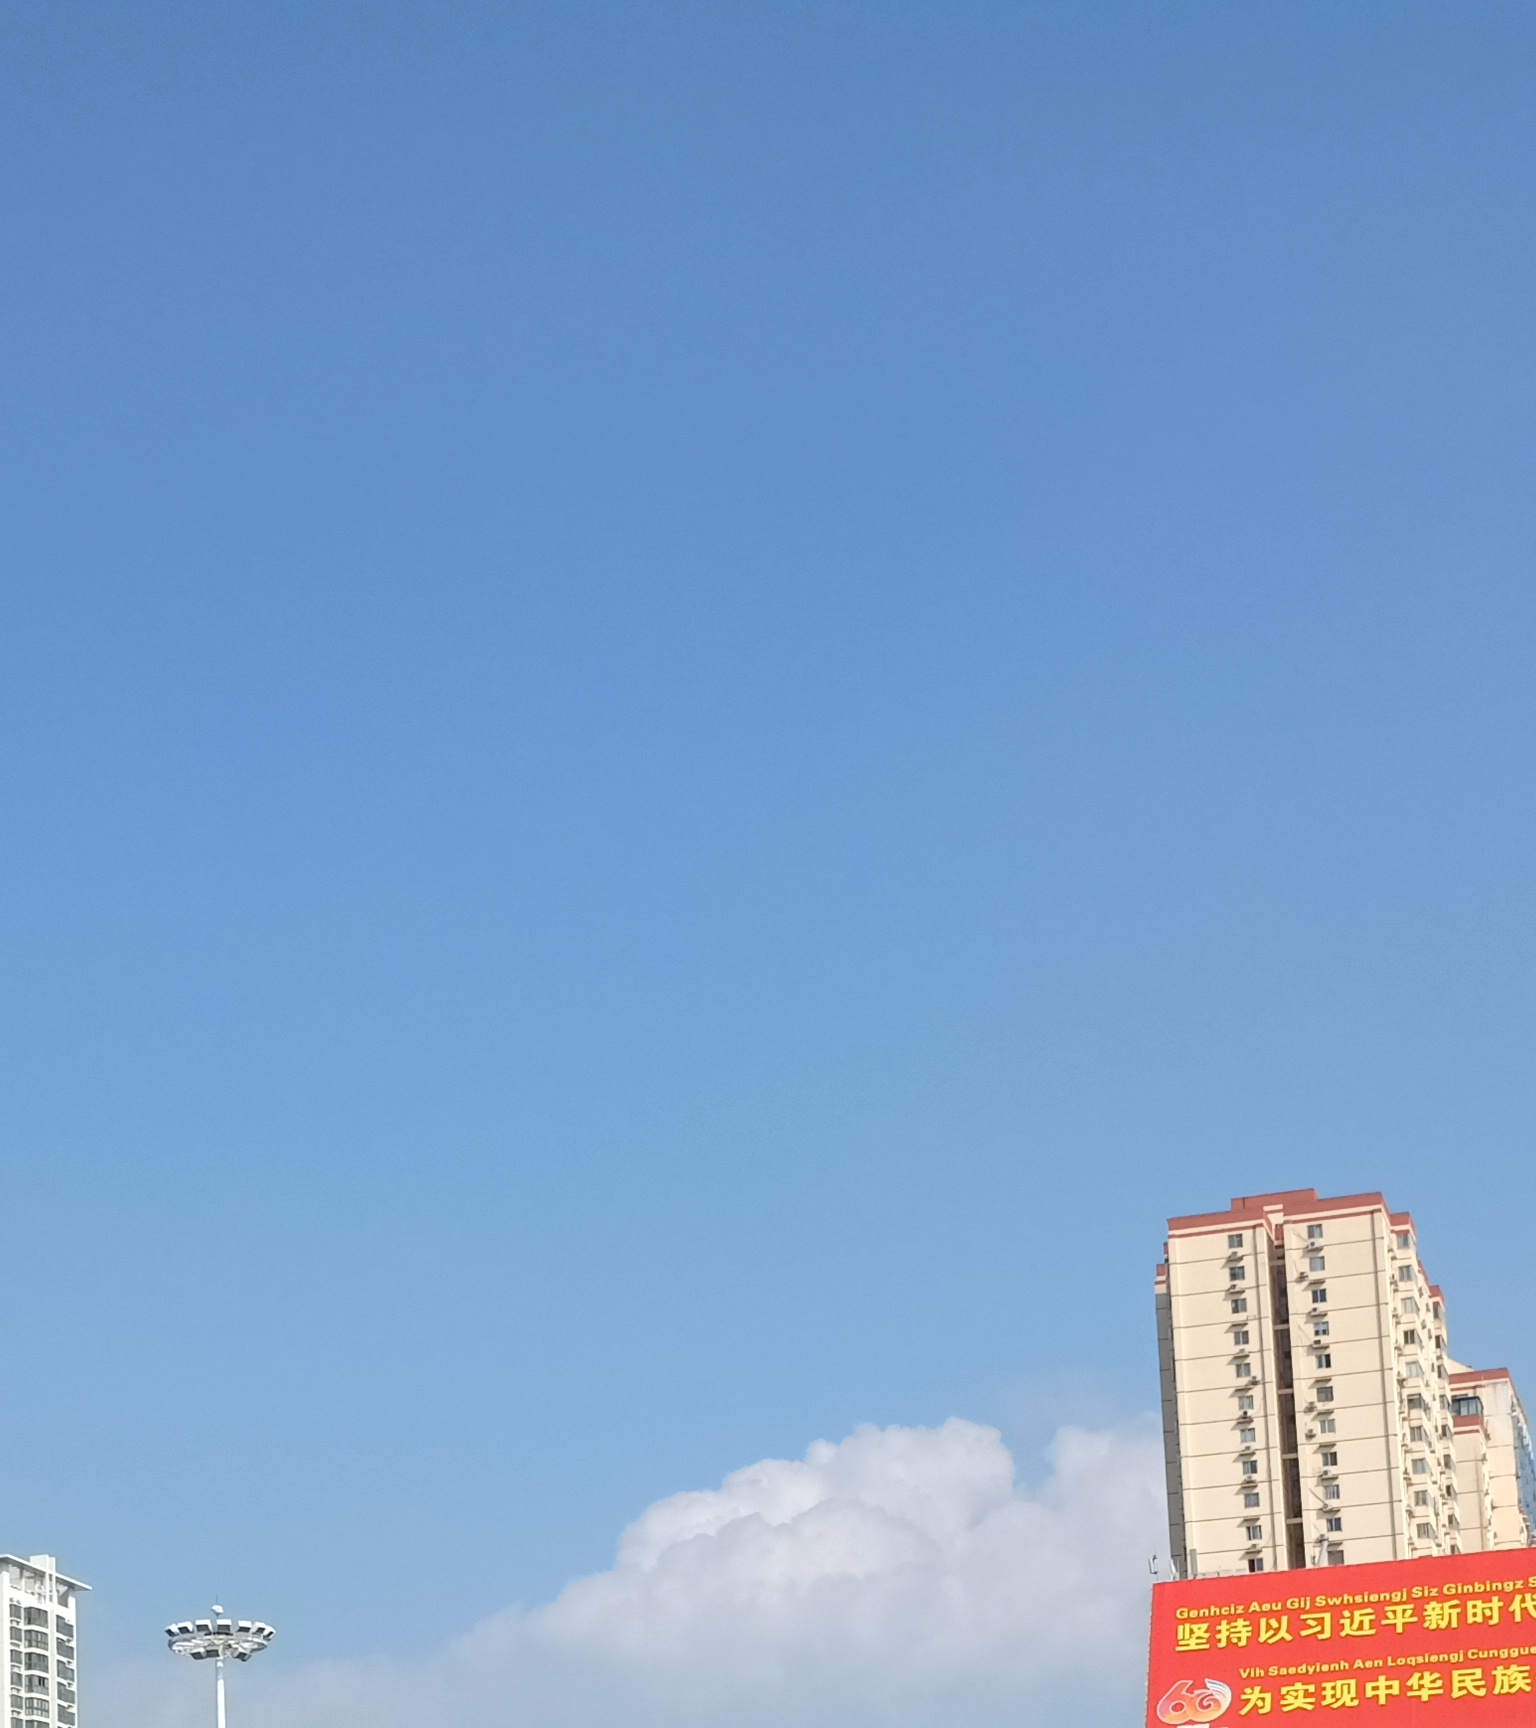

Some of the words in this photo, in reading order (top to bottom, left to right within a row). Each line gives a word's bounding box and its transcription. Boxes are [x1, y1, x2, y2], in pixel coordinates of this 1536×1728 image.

[1176, 1603, 1244, 1619] Genhciz
[1249, 1601, 1282, 1613] Aeu
[1286, 1597, 1311, 1611] Gij
[1315, 1588, 1407, 1607] Swhsiengj
[1411, 1584, 1439, 1598] Siz
[1443, 1579, 1524, 1596] Ginbingz
[1239, 1668, 1264, 1679] Vih
[1268, 1660, 1349, 1678] Saedyienh
[1353, 1658, 1383, 1669] Aen
[1387, 1649, 1464, 1667] Loqsiengj
